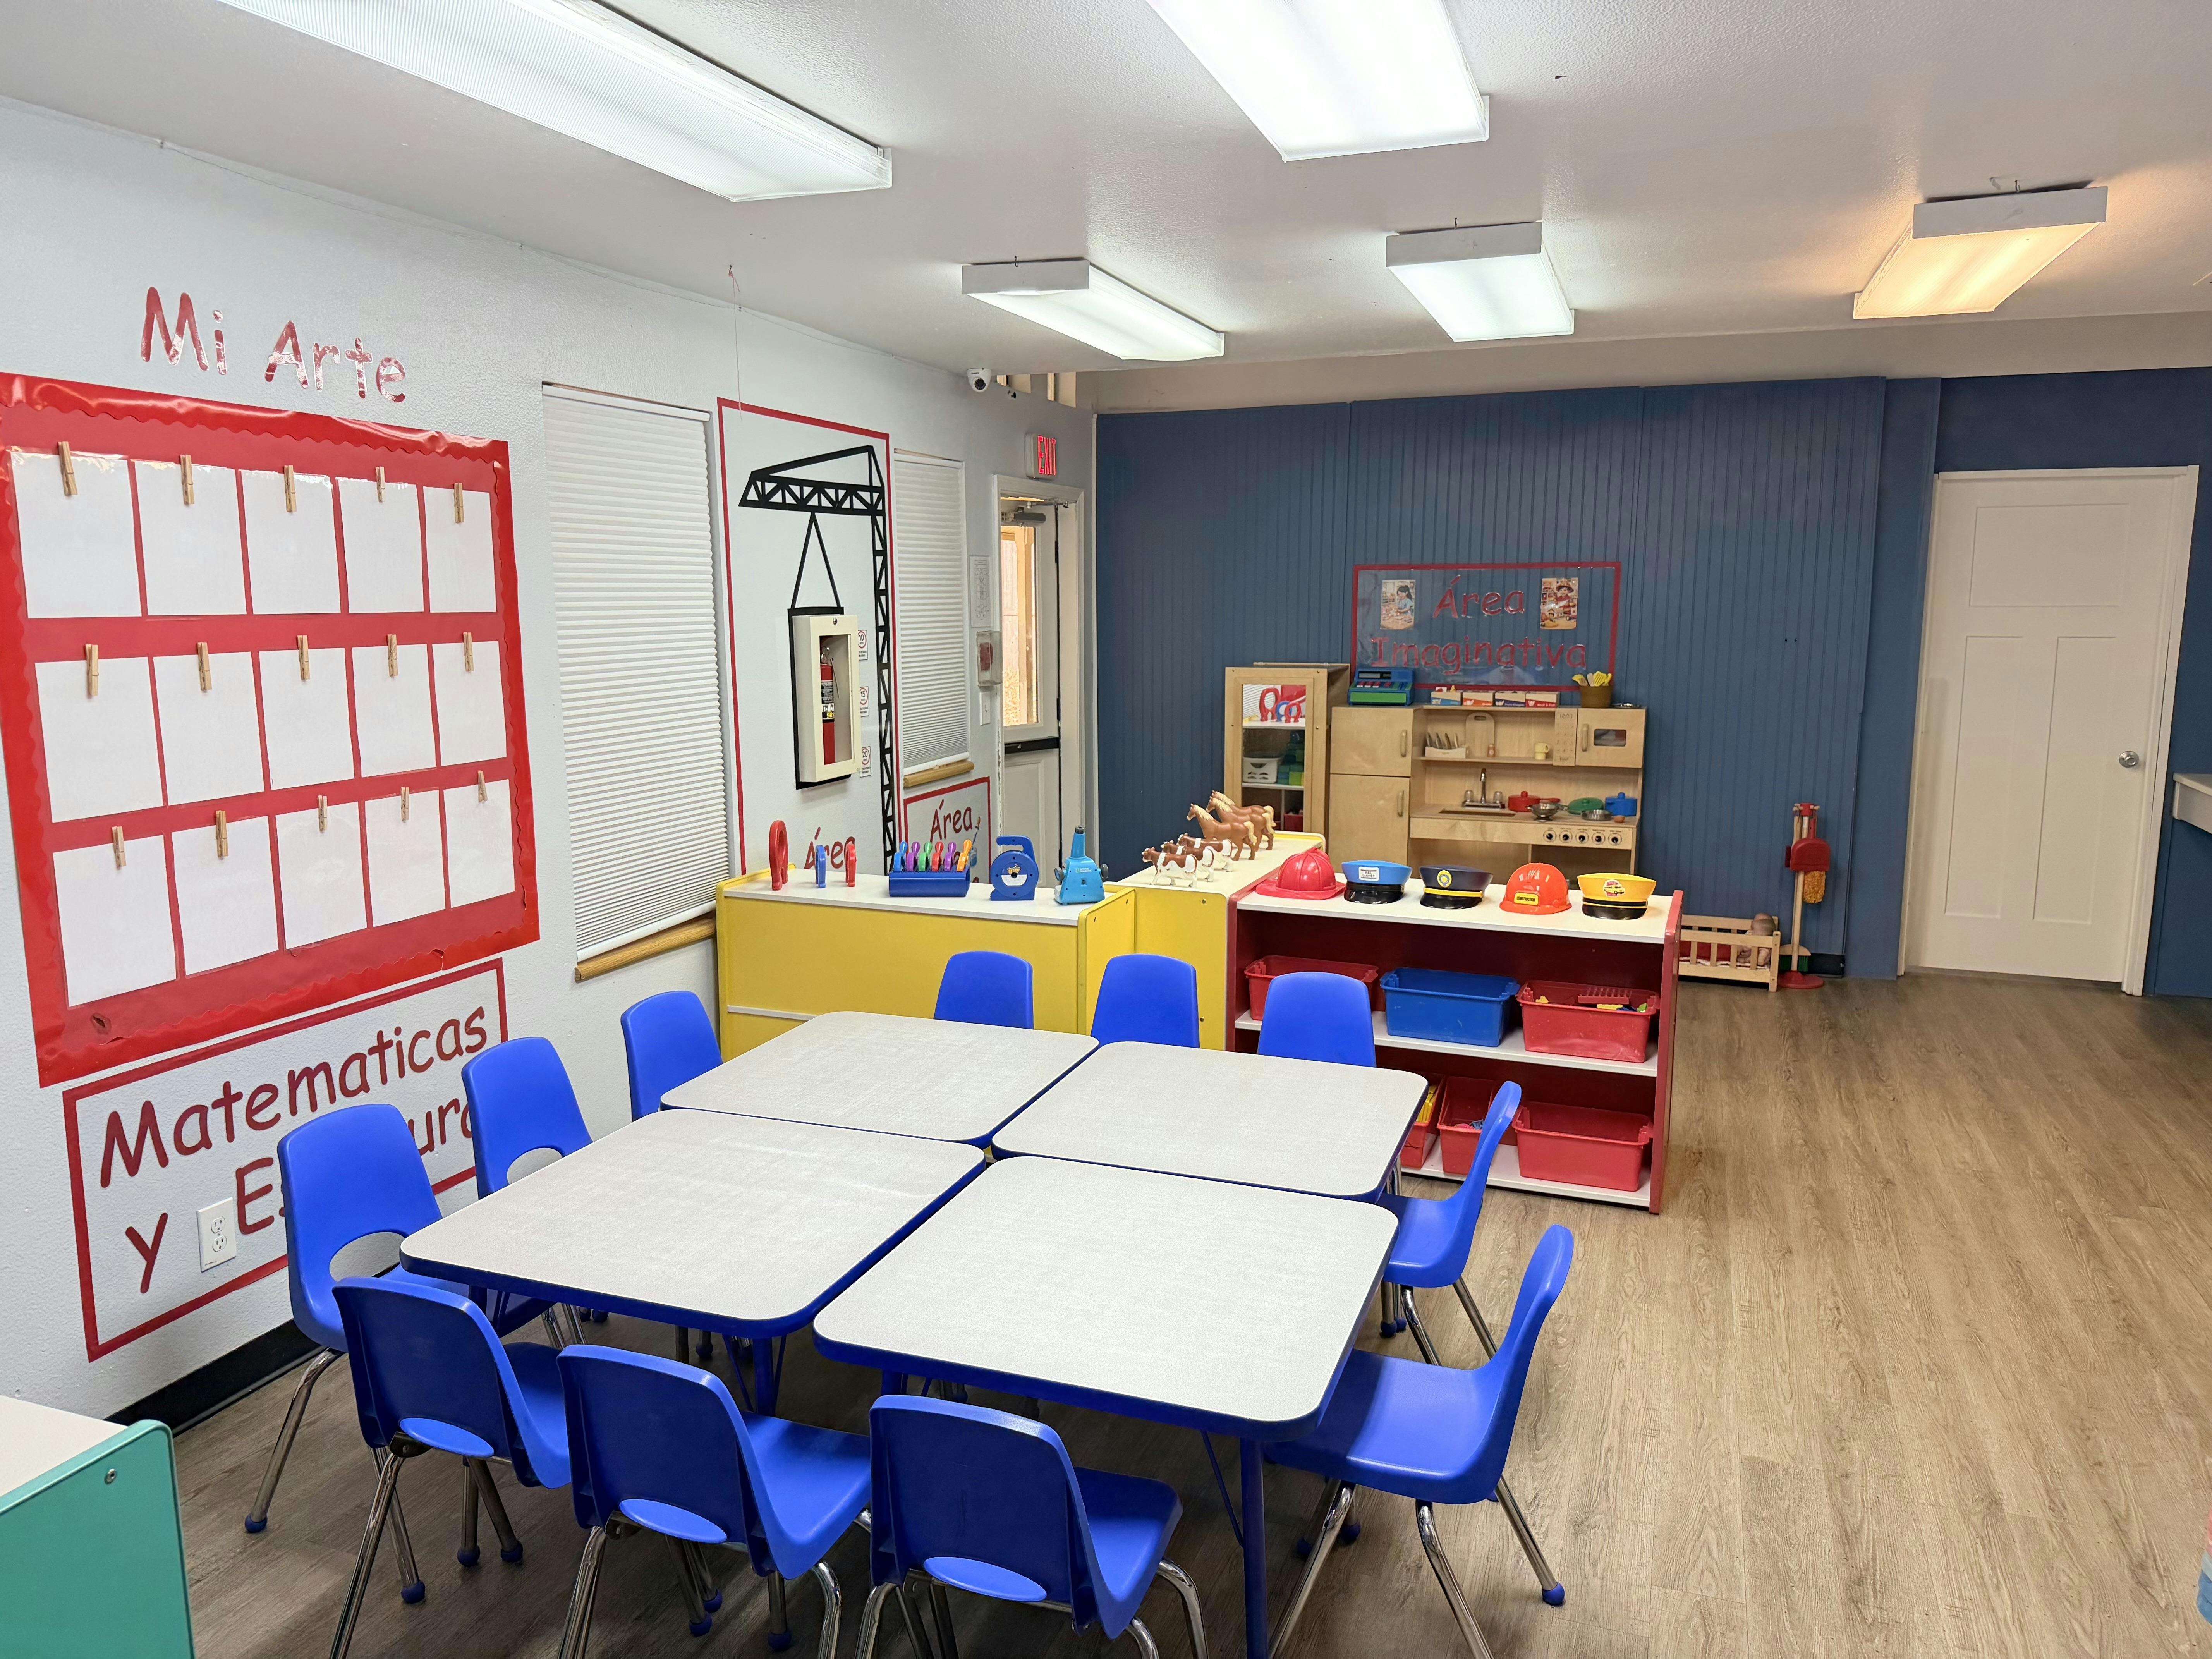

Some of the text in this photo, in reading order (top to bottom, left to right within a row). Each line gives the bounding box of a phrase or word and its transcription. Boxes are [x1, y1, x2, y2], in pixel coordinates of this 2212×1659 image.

[141, 286, 405, 403] Mi Arte
[1037, 435, 1057, 476] EXIT
[1432, 574, 1525, 619] Área
[1370, 636, 1587, 675] Imaginativa
[930, 799, 973, 843] Área
[101, 1006, 488, 1188] Matematicas
